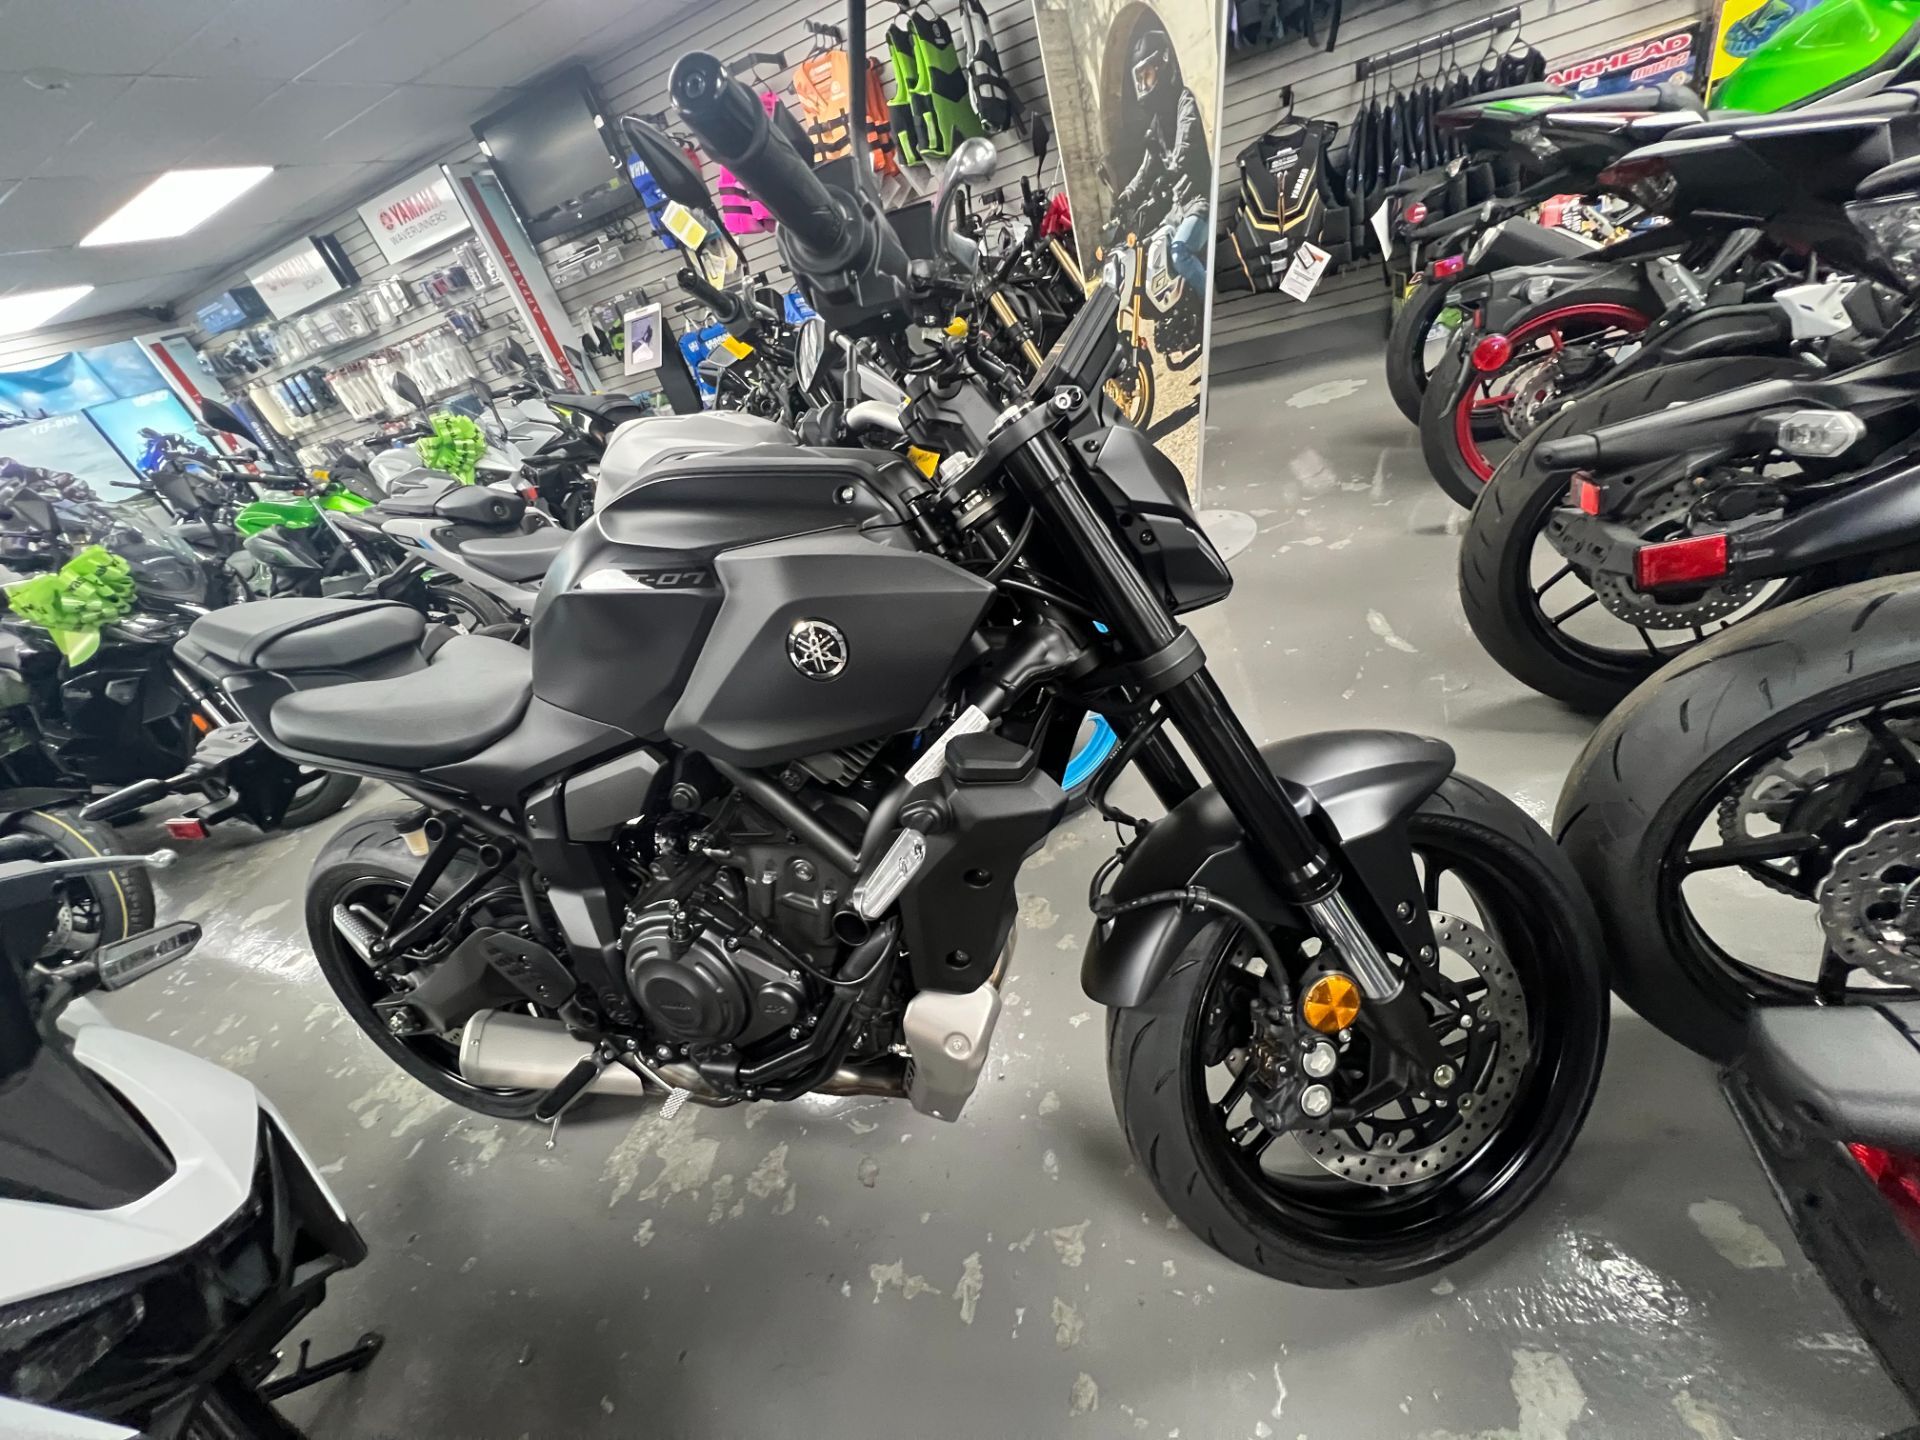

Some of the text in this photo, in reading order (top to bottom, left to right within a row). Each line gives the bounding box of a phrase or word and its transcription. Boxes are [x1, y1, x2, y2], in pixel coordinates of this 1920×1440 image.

[1544, 33, 1692, 87] AIRHEAD
[1291, 168, 1309, 199] YAMAHA
[388, 186, 441, 226] YAMAHA
[390, 210, 448, 246] WAVERUNNERS
[503, 252, 541, 315] APPAREL
